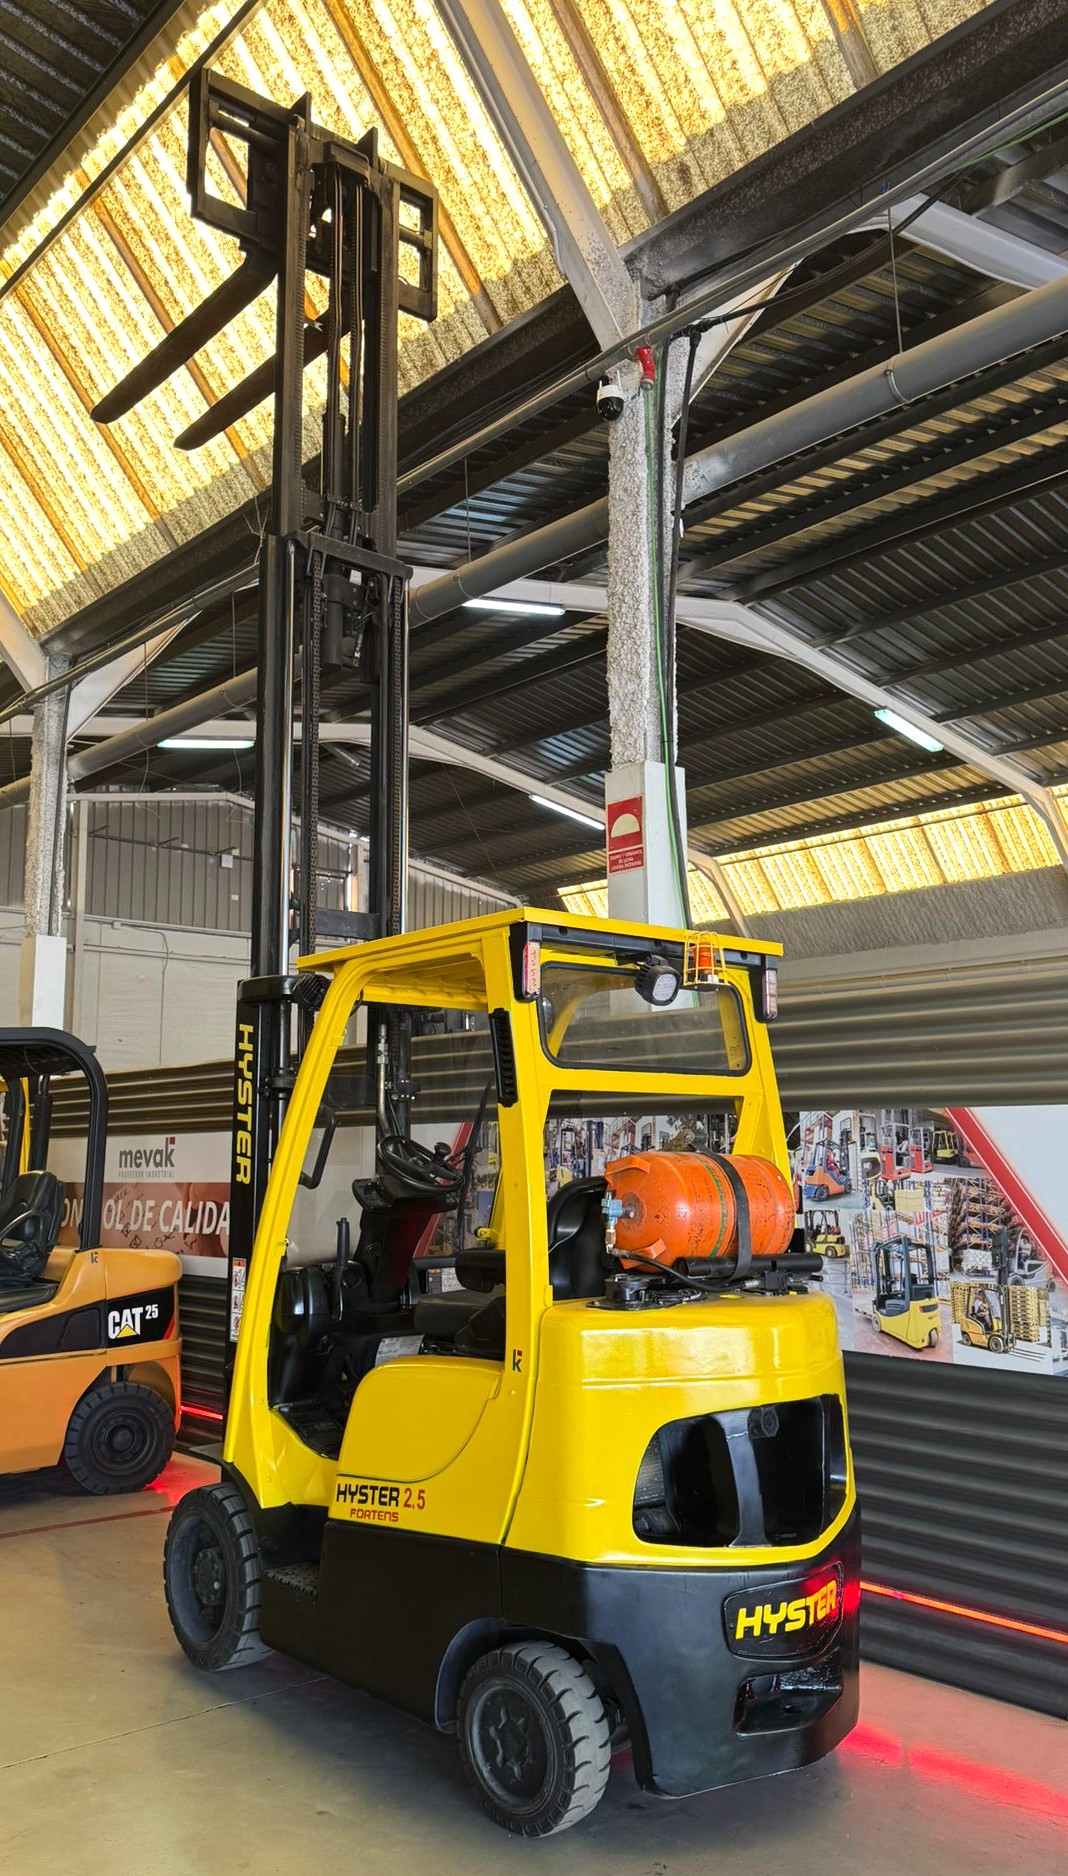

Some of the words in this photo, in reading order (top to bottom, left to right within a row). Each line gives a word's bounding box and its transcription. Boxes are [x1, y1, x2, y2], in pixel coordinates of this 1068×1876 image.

[236, 1023, 254, 1185] HYSTER
[119, 1137, 175, 1168] mevak
[130, 1200, 155, 1231] DE
[159, 1200, 230, 1236] CALIDA
[108, 1307, 143, 1339] CAT
[145, 1304, 159, 1320] 25
[336, 1483, 400, 1507] HYSTER
[403, 1487, 426, 1510] 2.5
[350, 1508, 399, 1522] FORTENS
[735, 1579, 837, 1640] HYSTER
